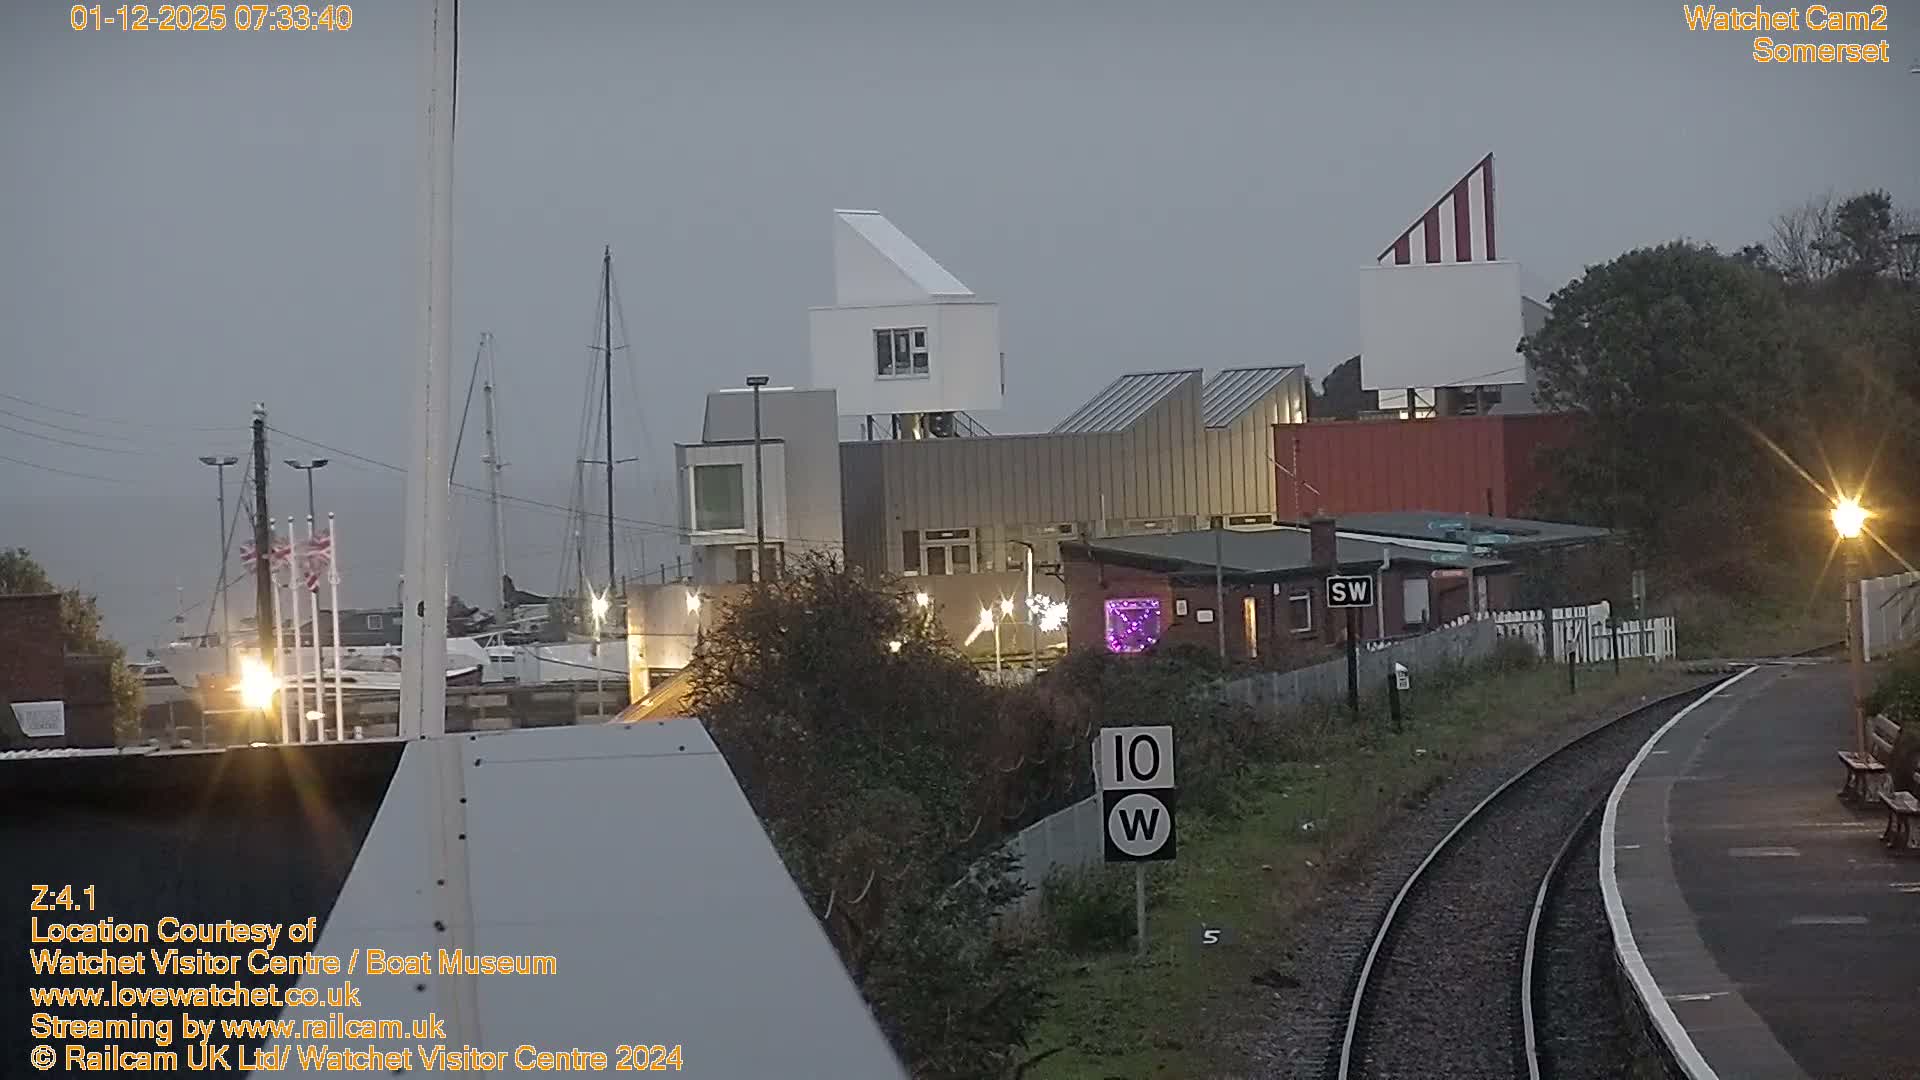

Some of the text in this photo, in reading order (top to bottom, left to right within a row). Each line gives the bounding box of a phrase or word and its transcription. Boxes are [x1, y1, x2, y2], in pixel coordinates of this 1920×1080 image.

[1332, 581, 1367, 602] SW
[1115, 734, 1160, 782] 10
[1118, 808, 1160, 841] W
